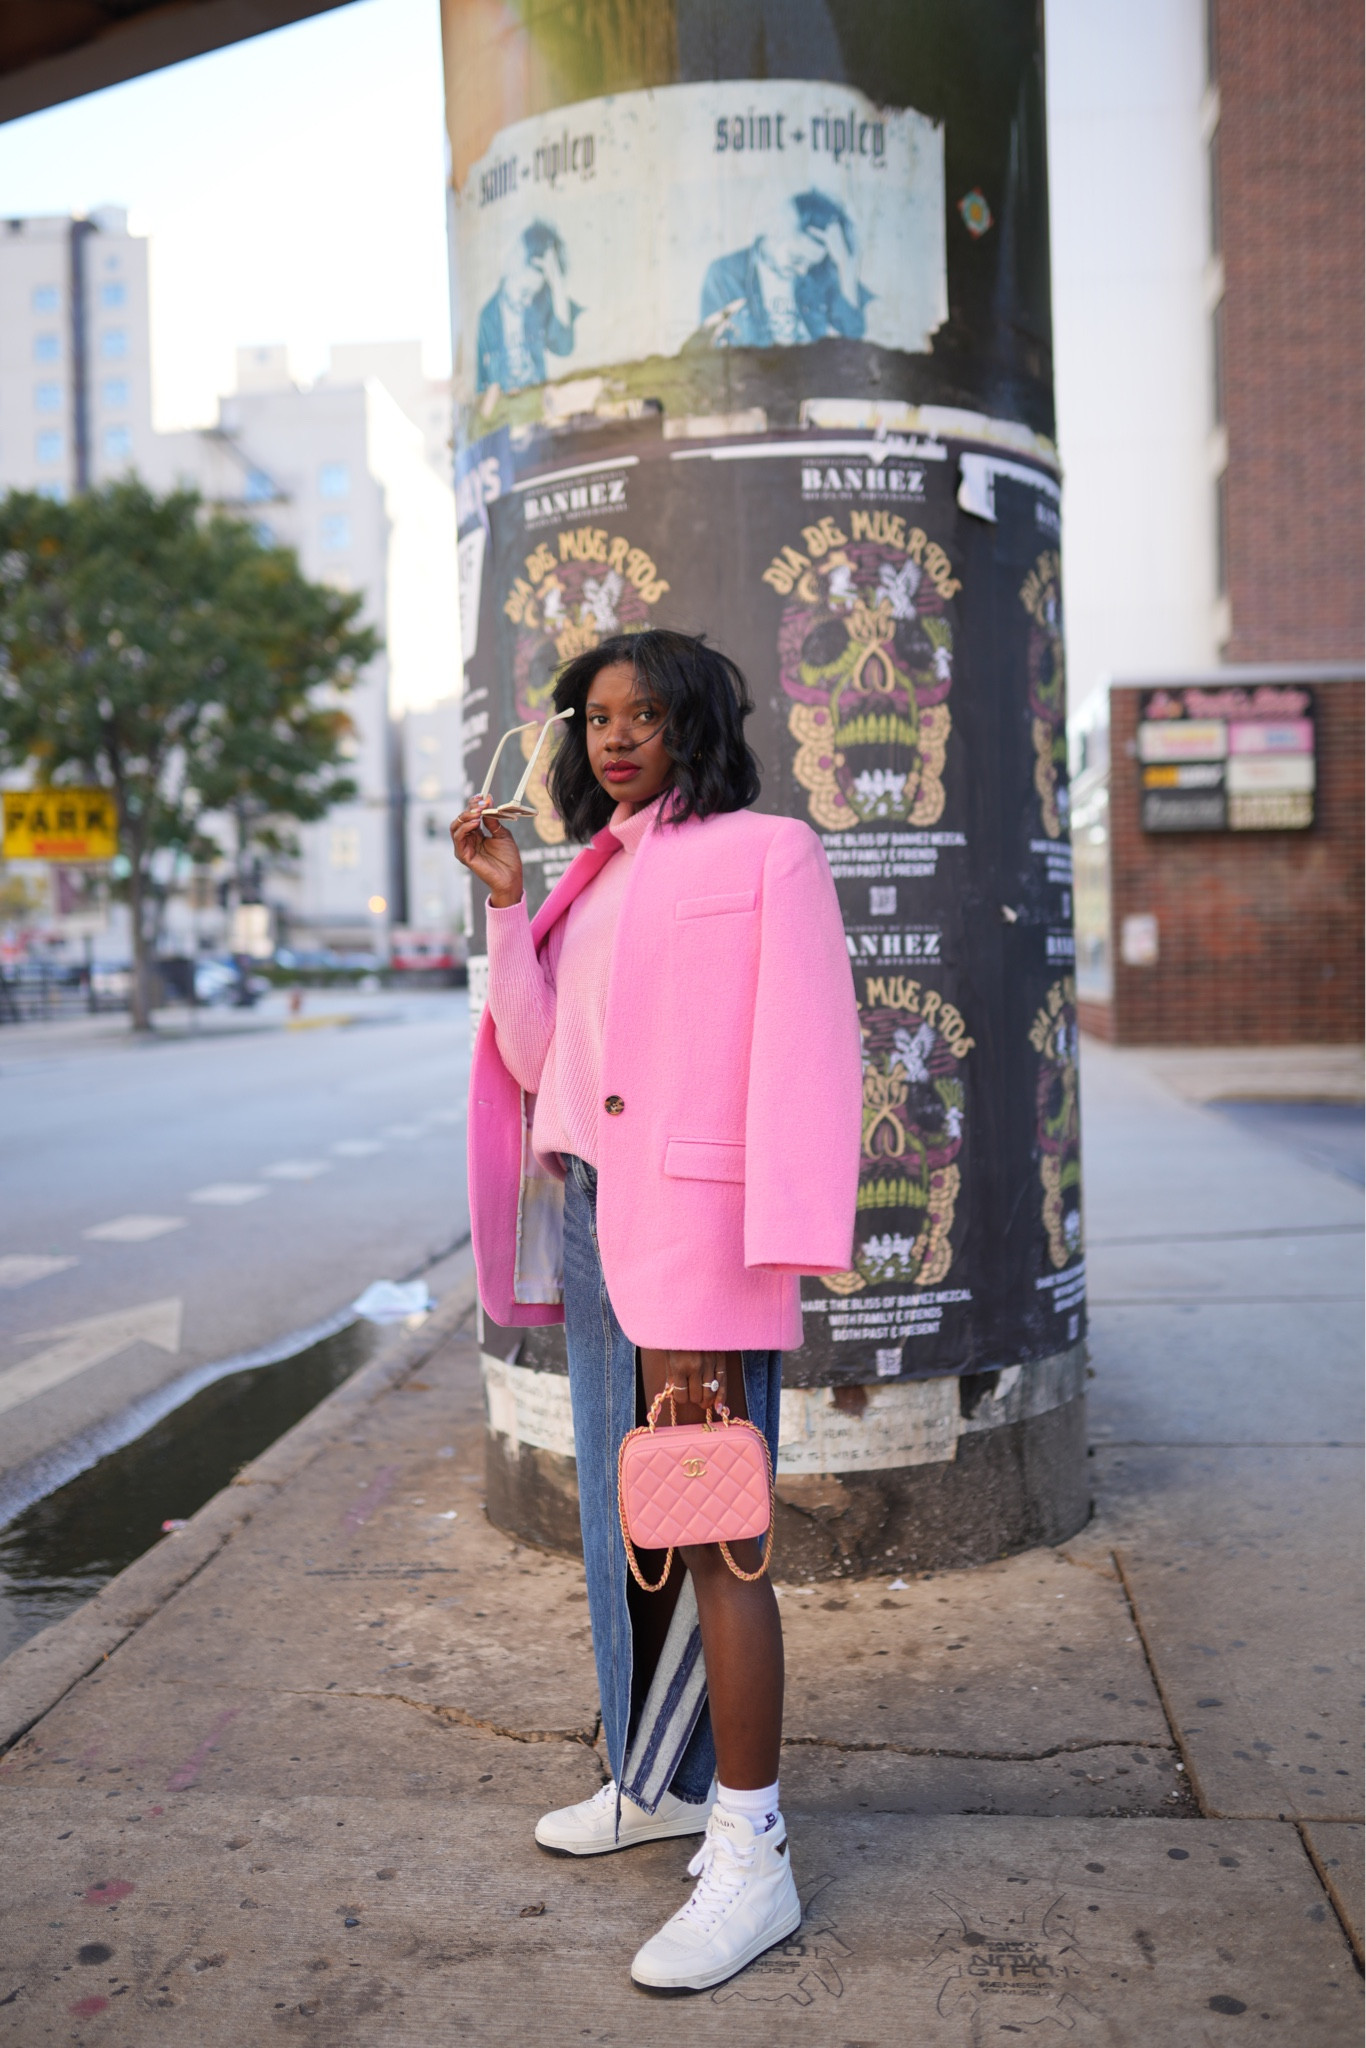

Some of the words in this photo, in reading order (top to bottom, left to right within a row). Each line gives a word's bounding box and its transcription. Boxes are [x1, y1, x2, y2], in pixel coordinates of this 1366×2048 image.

[715, 106, 786, 152] saint
[811, 108, 887, 168] ripley
[480, 154, 517, 207] saint
[533, 129, 597, 191] ripley
[801, 467, 925, 492] BANHEZ
[524, 479, 627, 520] BANHEZ
[761, 545, 812, 595] DIA
[801, 516, 849, 557] DE
[850, 510, 963, 600] MUERTOS
[845, 933, 941, 957] ANHEZ
[865, 975, 976, 1059] MUERTOS
[801, 1299, 828, 1312] HARE
[829, 1299, 850, 1311] THE
[882, 1295, 897, 1308] OF
[936, 1289, 973, 1304] MEZCAL
[829, 1314, 857, 1326] WITH
[857, 1311, 894, 1325] FAMILY
[832, 1328, 861, 1341] BOTH
[862, 1326, 889, 1340] PAST
